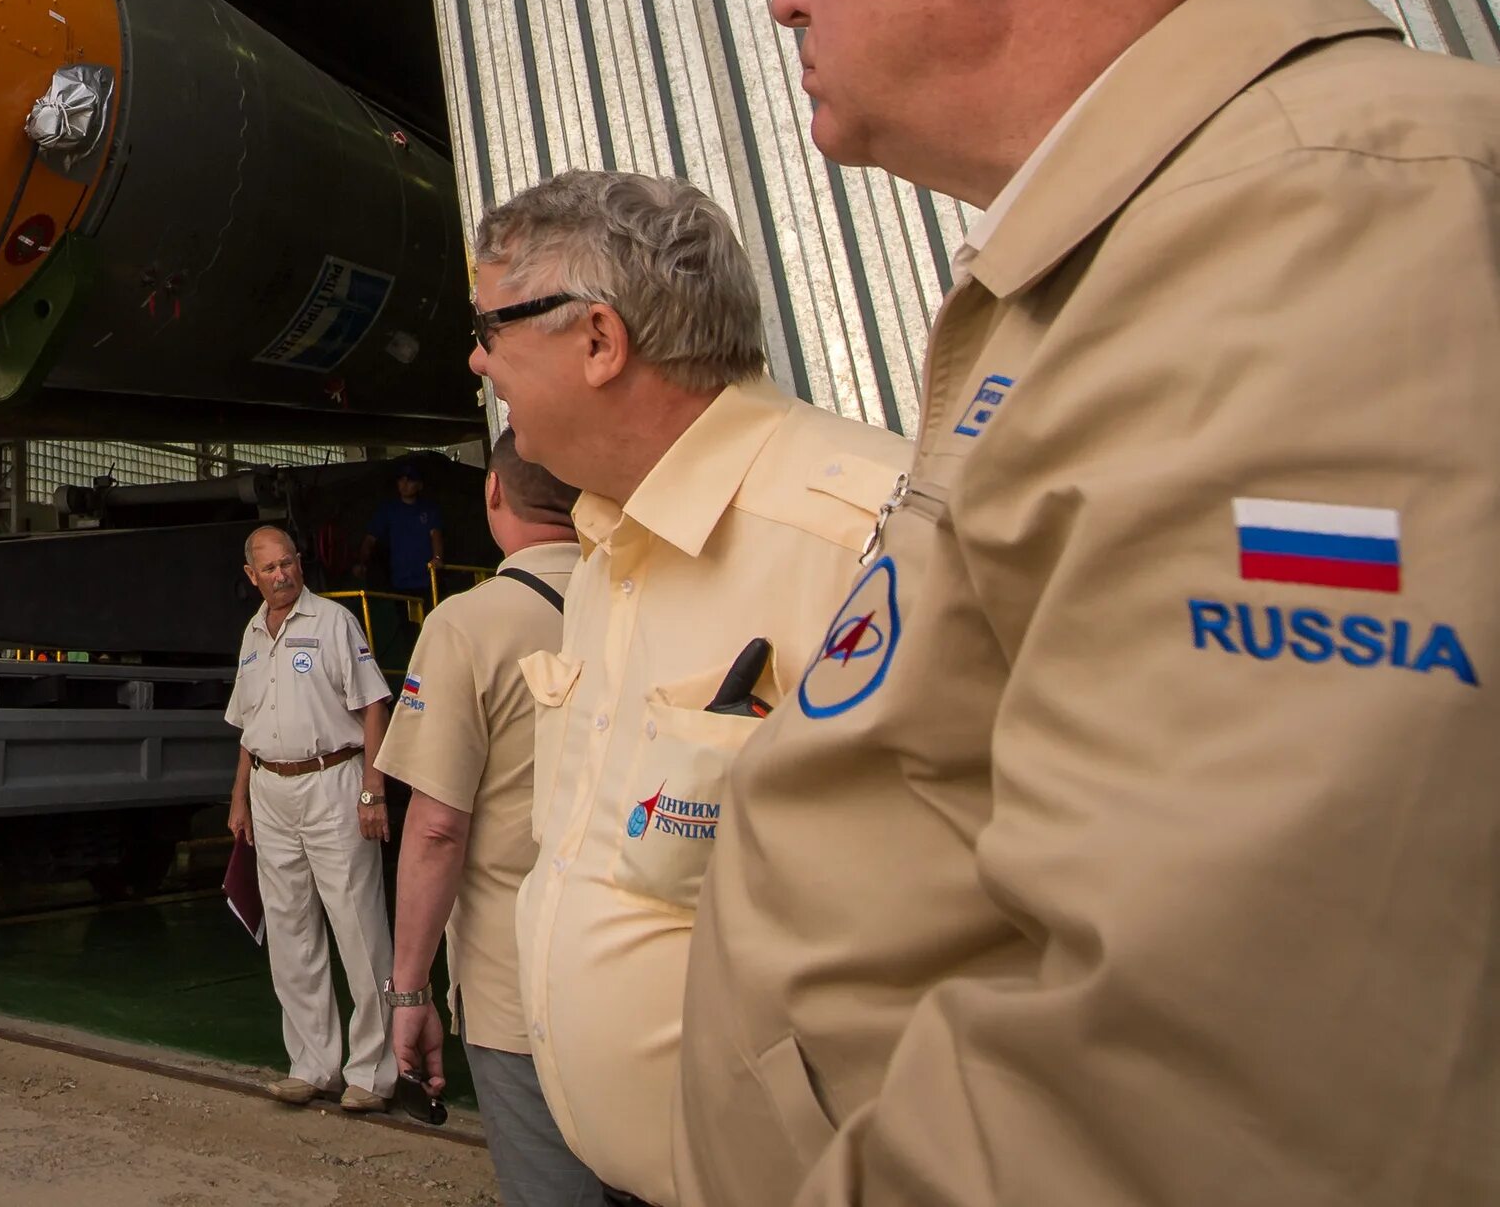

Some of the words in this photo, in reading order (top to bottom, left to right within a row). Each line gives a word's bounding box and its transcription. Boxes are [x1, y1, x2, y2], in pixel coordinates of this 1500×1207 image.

[1188, 597, 1479, 687] RUSSIA
[401, 695, 426, 711] СИЯ
[657, 795, 720, 818] ЦНИИМ
[655, 815, 716, 839] TSNIIM
